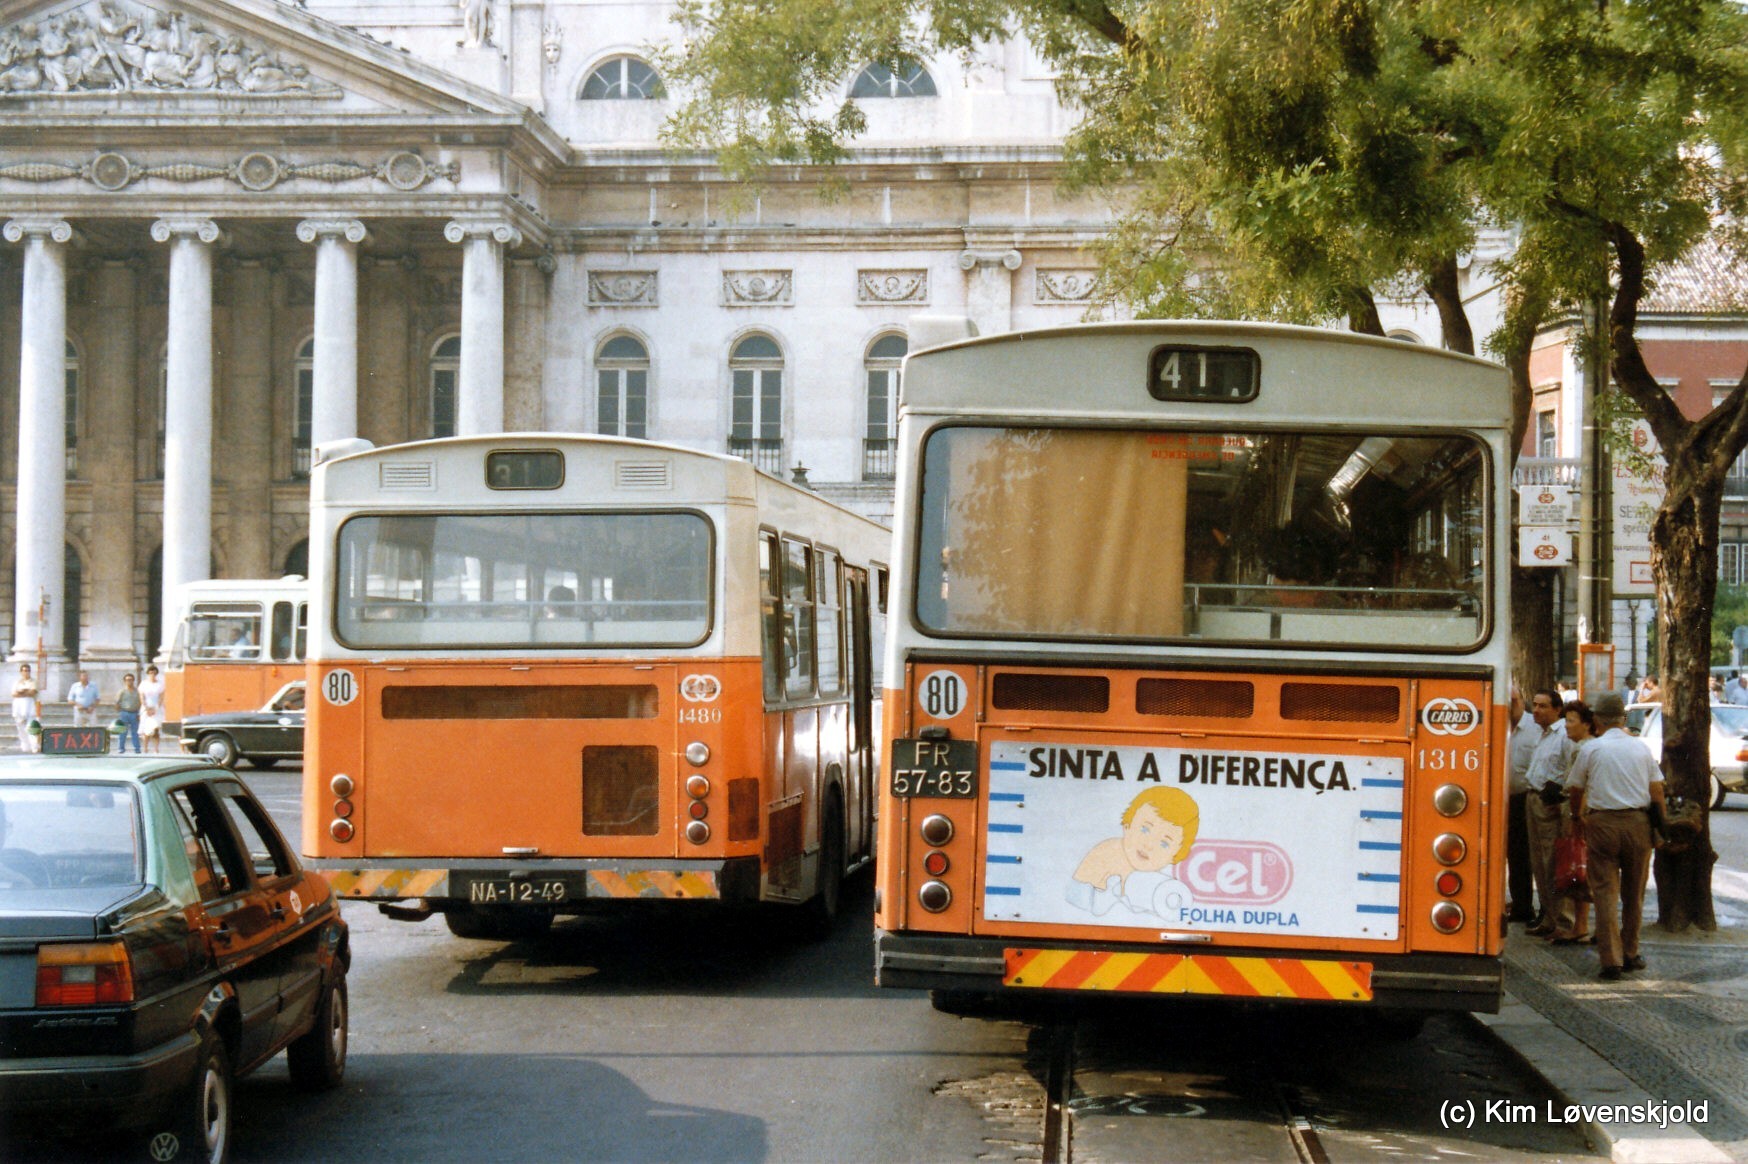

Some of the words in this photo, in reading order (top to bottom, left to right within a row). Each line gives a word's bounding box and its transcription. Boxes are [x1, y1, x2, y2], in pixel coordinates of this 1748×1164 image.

[1160, 351, 1206, 389] 41
[329, 672, 350, 702] 80
[927, 676, 958, 715] 80
[678, 708, 721, 724] 1480
[1430, 711, 1470, 723] CARRIS
[50, 732, 99, 749] TAXI
[915, 742, 949, 766] FR
[1419, 748, 1479, 771] 1316
[894, 769, 973, 794] 57-83
[1029, 748, 1124, 781] SINTA
[1137, 752, 1161, 782] A
[1178, 753, 1357, 795] DIFERENÇA.
[471, 882, 566, 902] NA-12-49
[1179, 907, 1237, 924] FOLHA
[1243, 911, 1300, 927] DUPLA
